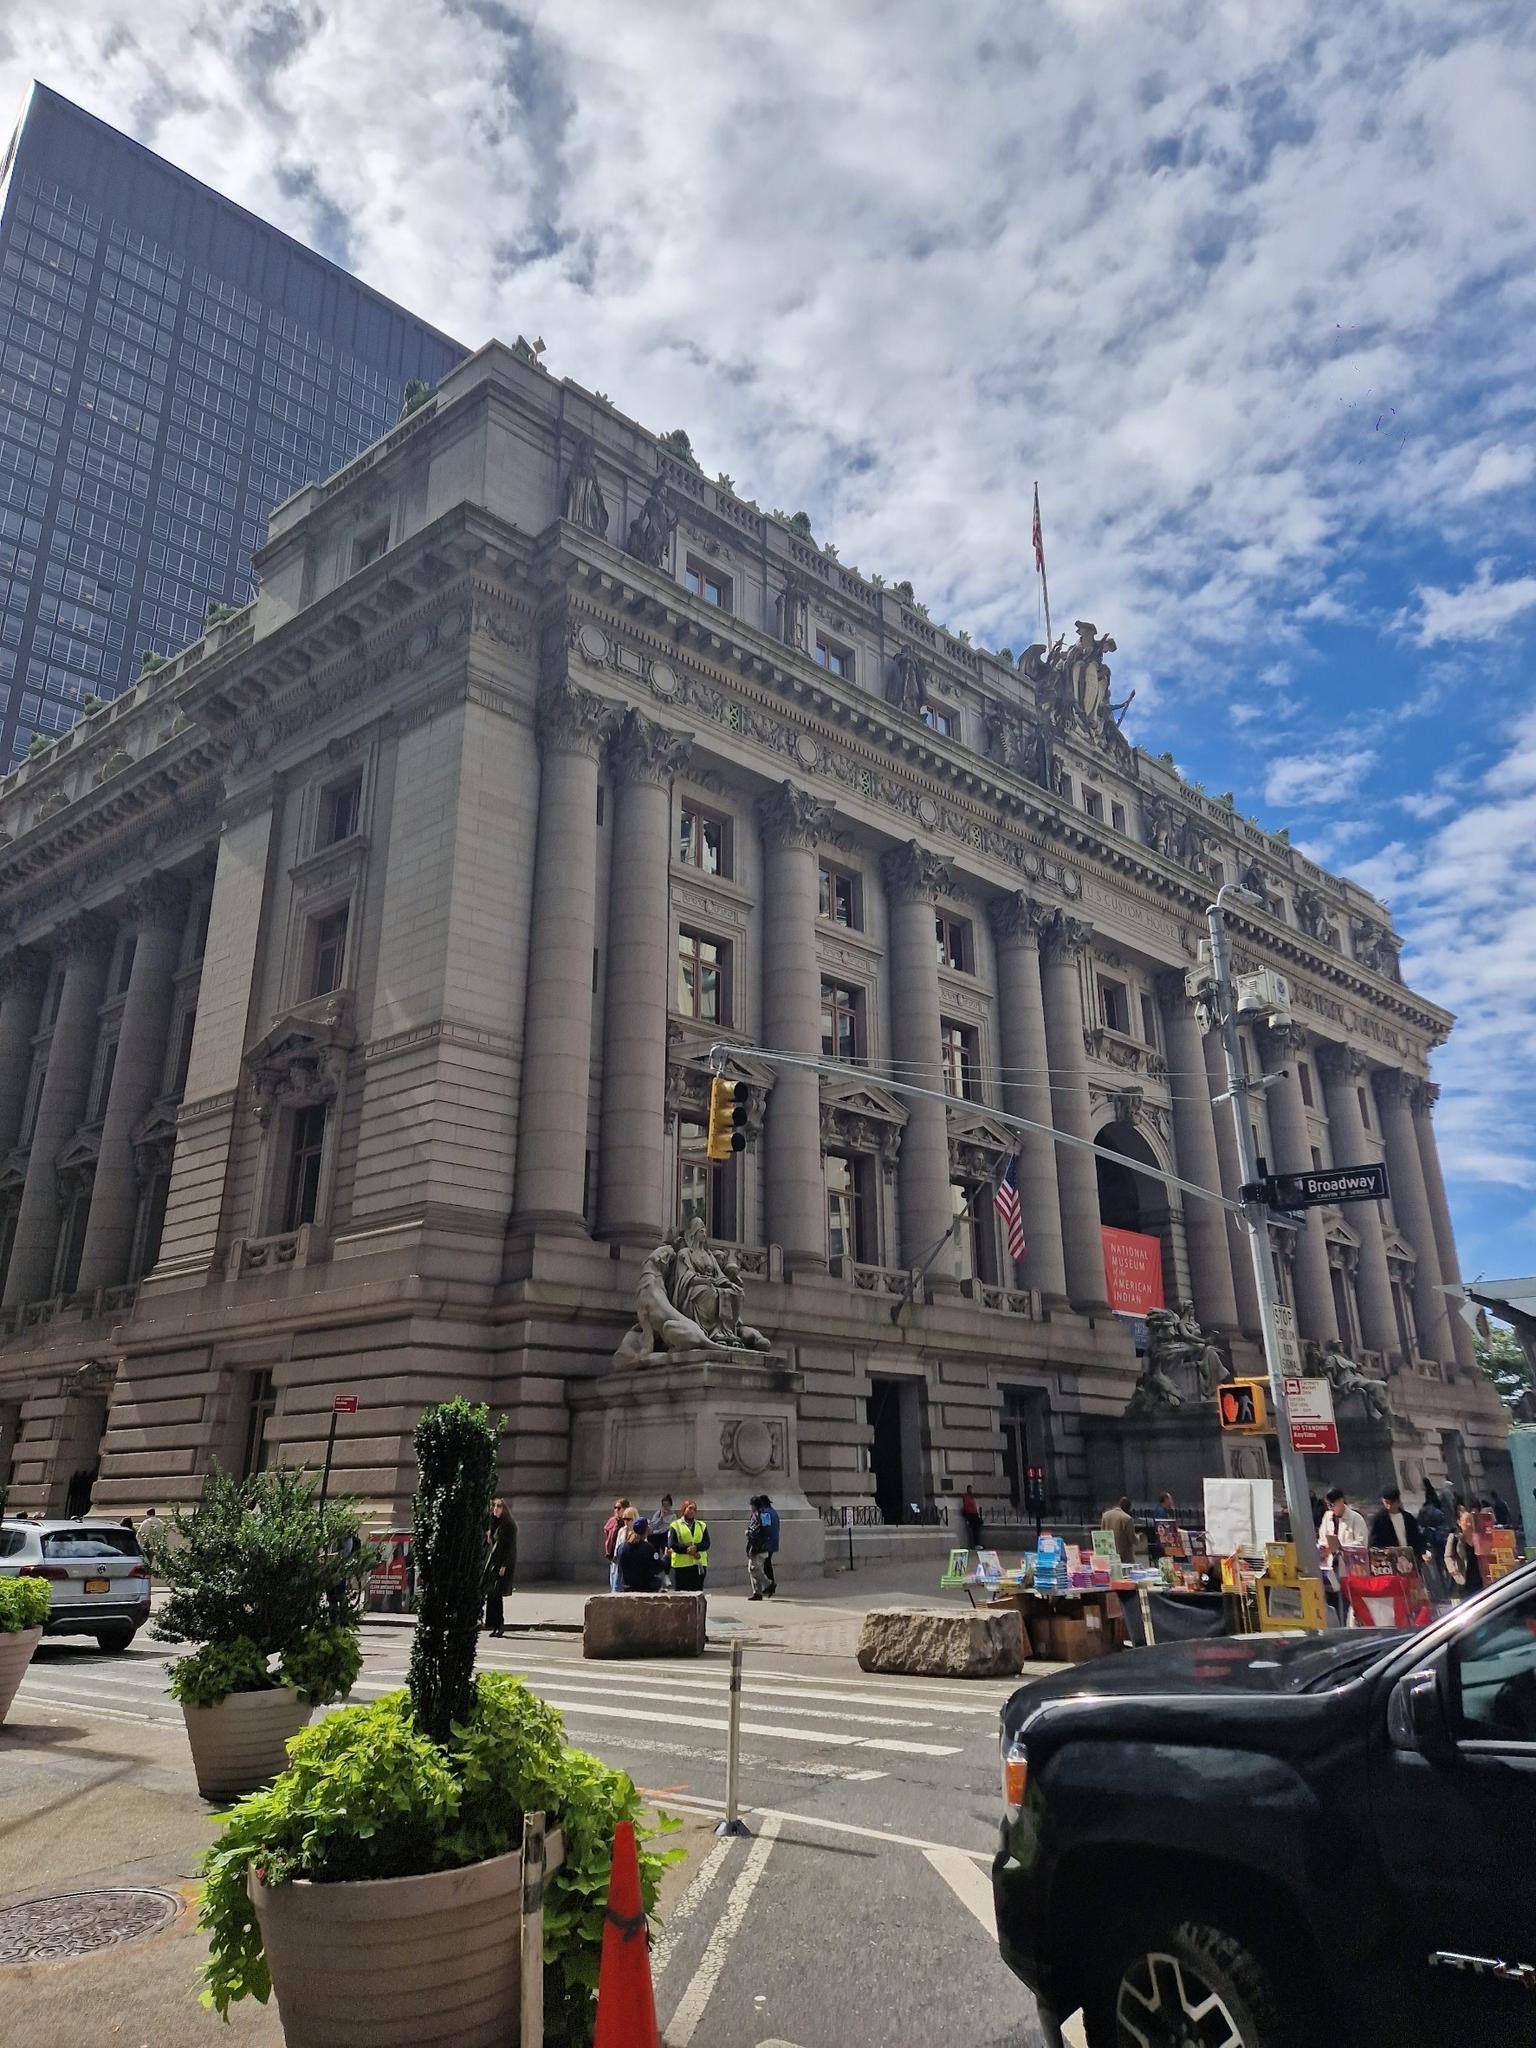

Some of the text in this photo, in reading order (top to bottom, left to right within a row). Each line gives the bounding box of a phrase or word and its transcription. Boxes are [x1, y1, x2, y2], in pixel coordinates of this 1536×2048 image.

[1104, 894, 1142, 920] CUSTOM
[1146, 912, 1177, 940] HOUSE
[1308, 1176, 1375, 1193] Broadway
[1111, 1244, 1148, 1260] NATIONAL
[1112, 1257, 1145, 1272] MUSEUM
[1113, 1279, 1152, 1294] AMERICAN
[1113, 1290, 1142, 1305] INDIAN
[1274, 1308, 1292, 1326] STOP
